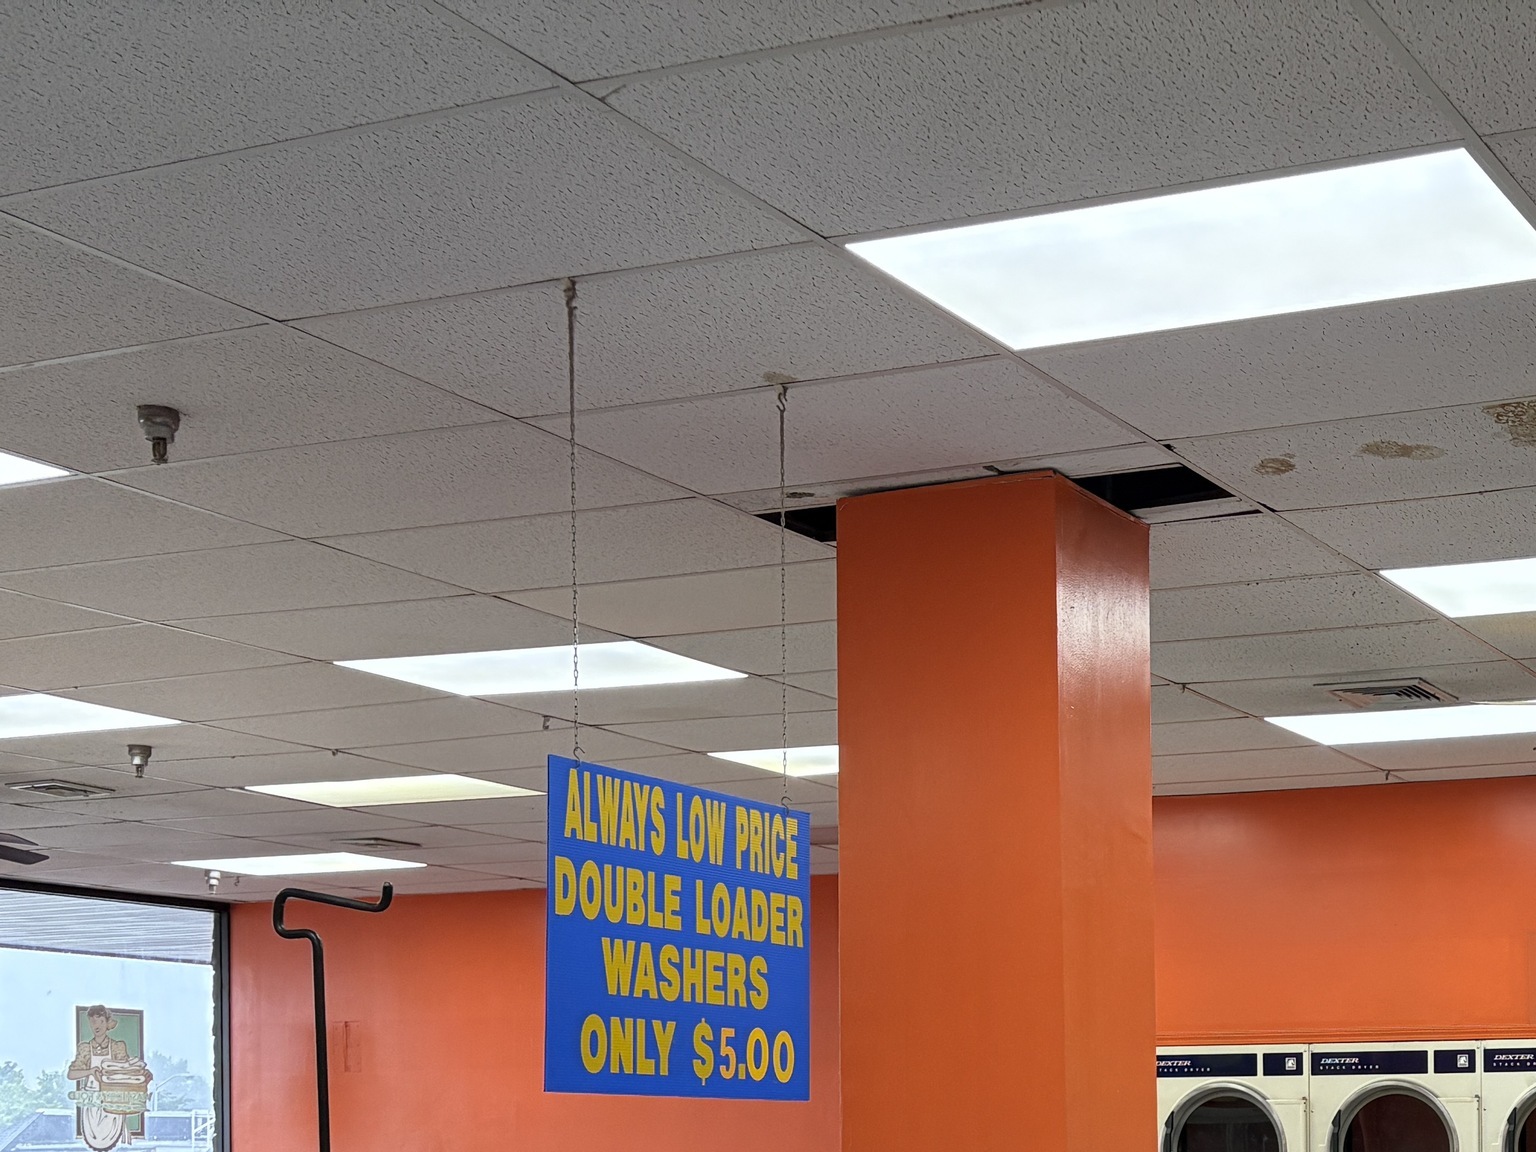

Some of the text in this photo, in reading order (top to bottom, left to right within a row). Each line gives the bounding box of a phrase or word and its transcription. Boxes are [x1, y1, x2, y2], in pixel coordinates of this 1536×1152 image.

[564, 768, 798, 880] ALWAYS LOW PRICE
[555, 856, 804, 948] DOUBLE LOADER
[601, 937, 769, 1010] WASHERS
[580, 1013, 796, 1086] ONLY $5.00
